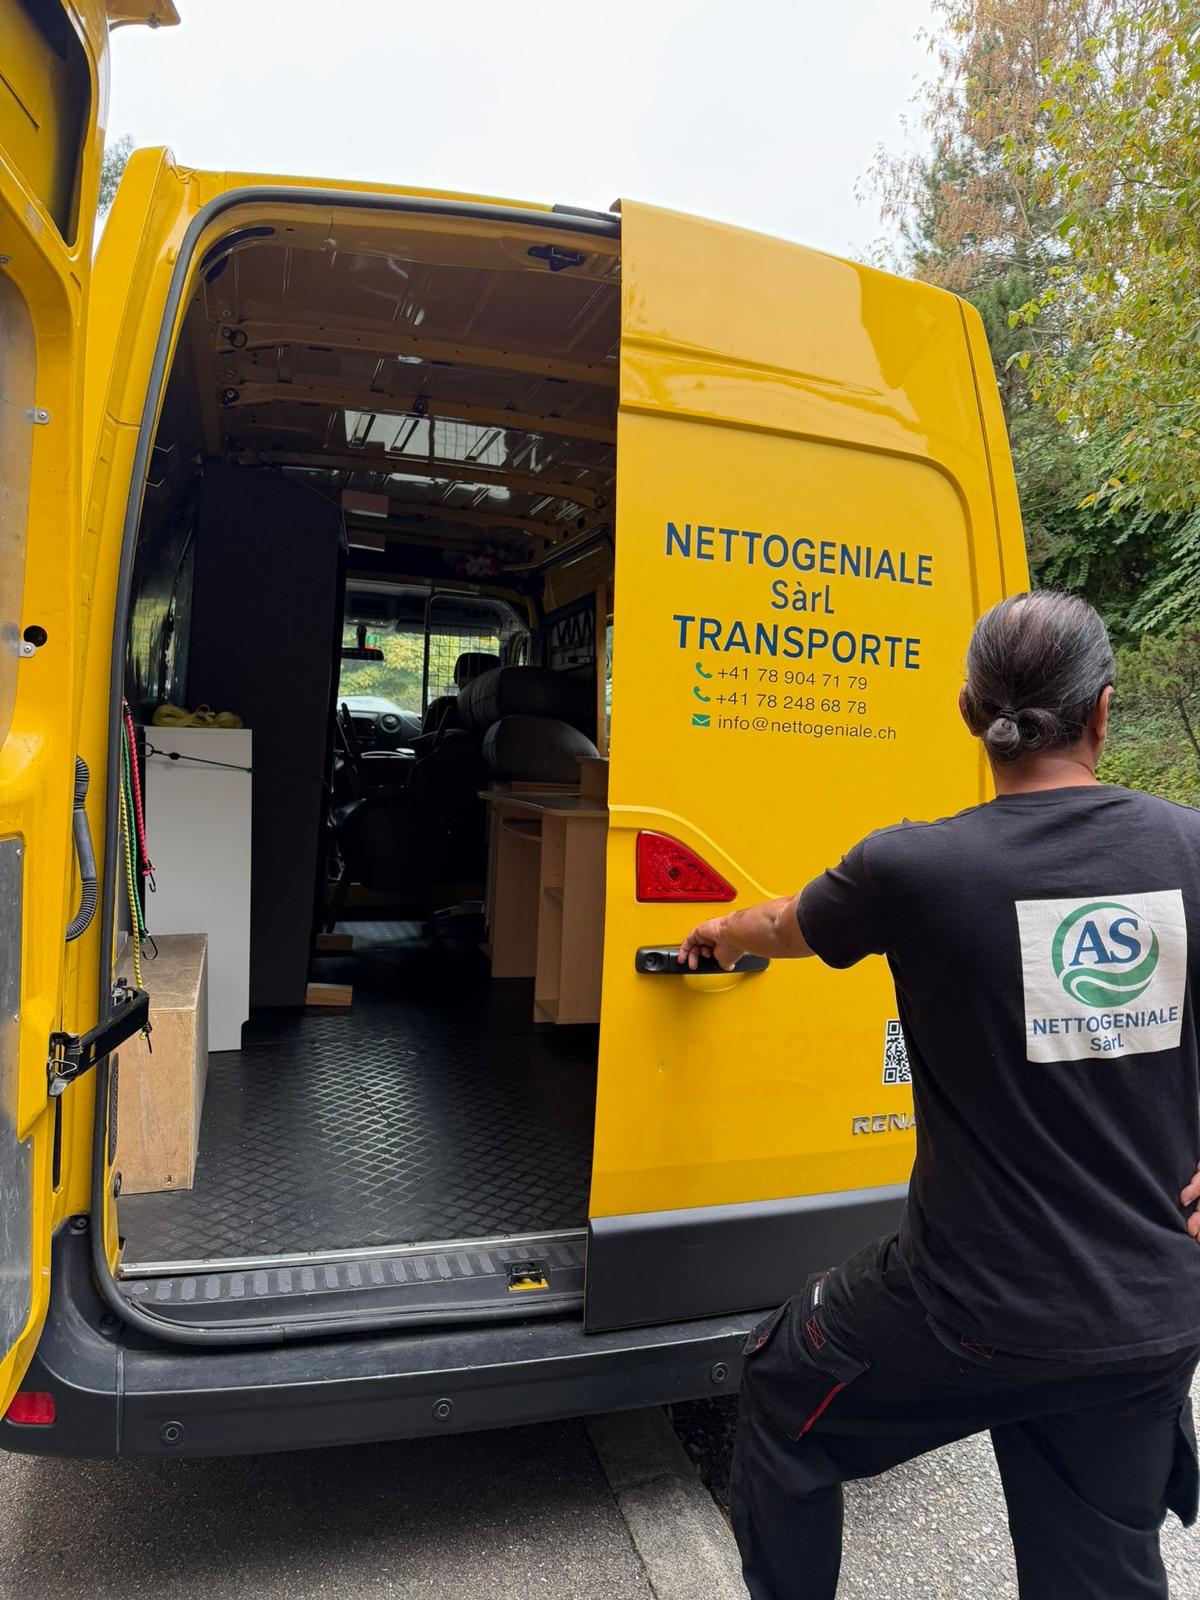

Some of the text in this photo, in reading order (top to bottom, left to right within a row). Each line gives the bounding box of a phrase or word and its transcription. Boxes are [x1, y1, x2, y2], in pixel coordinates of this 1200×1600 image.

[666, 522, 933, 586] NETTOGENIALE
[673, 614, 921, 669] TRANSPORTE
[717, 667, 868, 690] +41 78 904 71 79
[716, 692, 867, 715] +41 78 248 68 78
[718, 715, 896, 739] info@nettogeniale.ch
[1068, 918, 1141, 966] AS
[1033, 1006, 1179, 1035] NETTOGENIALE
